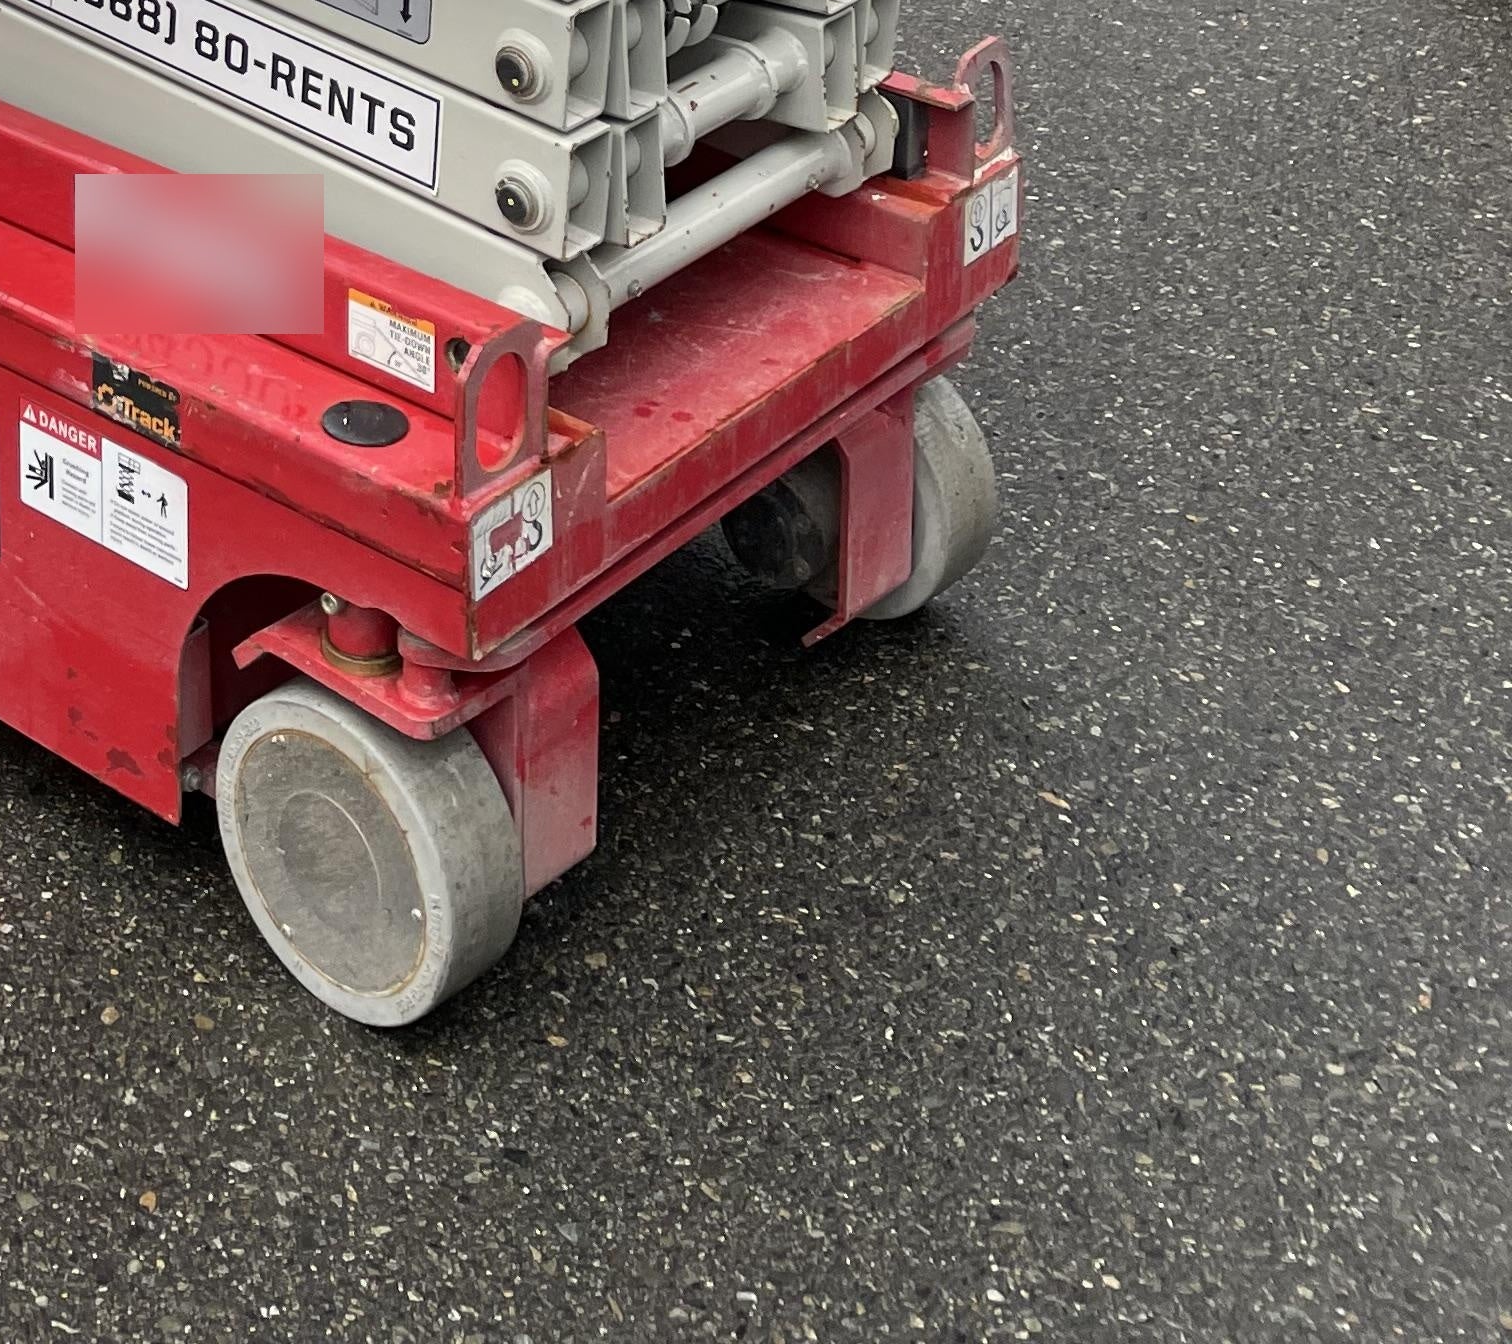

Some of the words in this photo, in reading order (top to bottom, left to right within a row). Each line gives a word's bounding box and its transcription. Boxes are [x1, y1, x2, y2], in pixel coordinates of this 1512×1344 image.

[194, 19, 416, 152] 80-RENTS
[389, 319, 431, 345] MAXIMUM
[404, 347, 430, 366] ANGLE
[38, 410, 98, 454] DANGER
